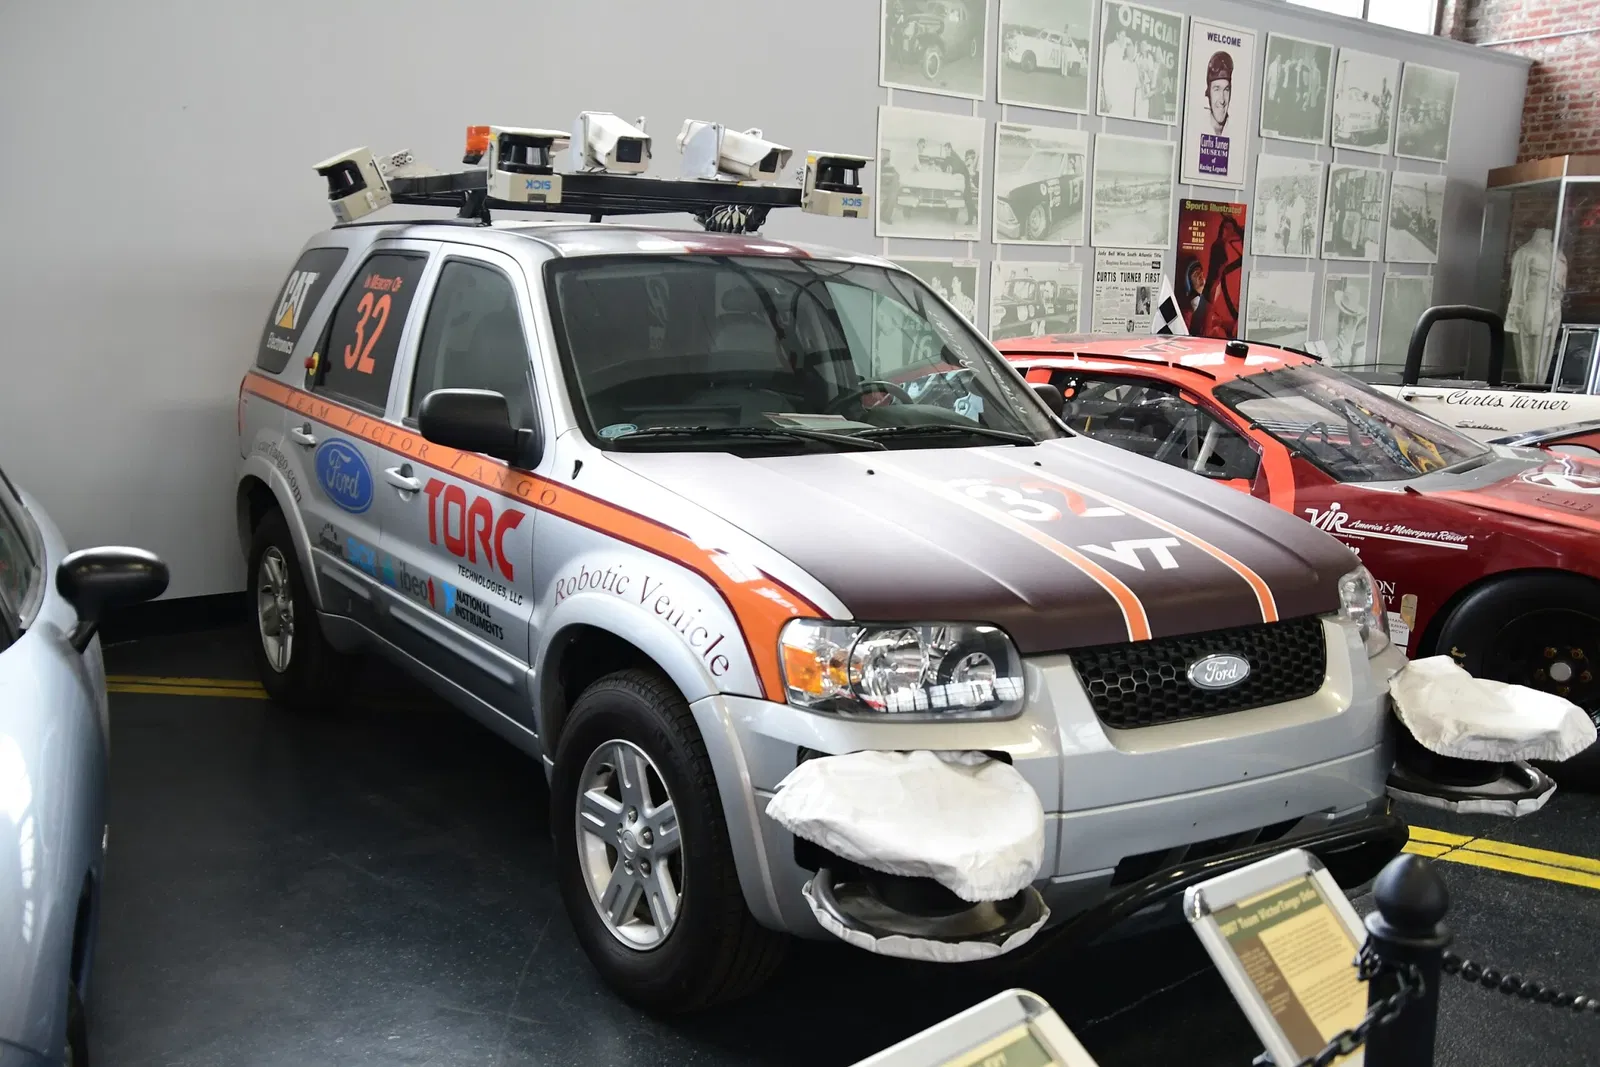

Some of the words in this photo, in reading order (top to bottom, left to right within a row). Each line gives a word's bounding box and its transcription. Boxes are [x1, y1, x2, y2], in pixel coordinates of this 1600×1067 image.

[1118, 5, 1179, 46] OFFICIAL
[1207, 32, 1241, 47] WELCOME
[1200, 147, 1228, 157] MUSEUM
[1214, 137, 1229, 150] Turner
[526, 179, 552, 190] SICK
[841, 196, 862, 207] SICK
[1185, 200, 1208, 211] Sports
[1209, 203, 1242, 214] Illustrated
[1096, 271, 1117, 282] CURTIS
[1120, 272, 1141, 282] TURNER
[1144, 273, 1161, 283] FIRST
[275, 270, 320, 330] CAT
[344, 291, 392, 374] 32
[1446, 391, 1504, 408] Curtis
[1509, 394, 1571, 411] Turner
[285, 390, 330, 420] TEAM
[344, 410, 429, 459] VICTOR
[449, 451, 557, 507] TANGO
[325, 448, 361, 500] Ford
[424, 477, 526, 583] TORC
[1304, 502, 1349, 533] VIR
[1348, 519, 1391, 533] America's
[1389, 525, 1438, 539] Motorsport
[1436, 530, 1468, 543] Resort
[1077, 538, 1181, 572] VT
[401, 561, 428, 601] ibeo
[457, 564, 508, 602] TECHNOLOGIES,
[509, 591, 523, 606] LLC
[553, 564, 630, 609] Robotic
[455, 603, 505, 641] INSTRUMENTS
[456, 589, 491, 619] NATIONAL
[1204, 660, 1239, 683] Ford
